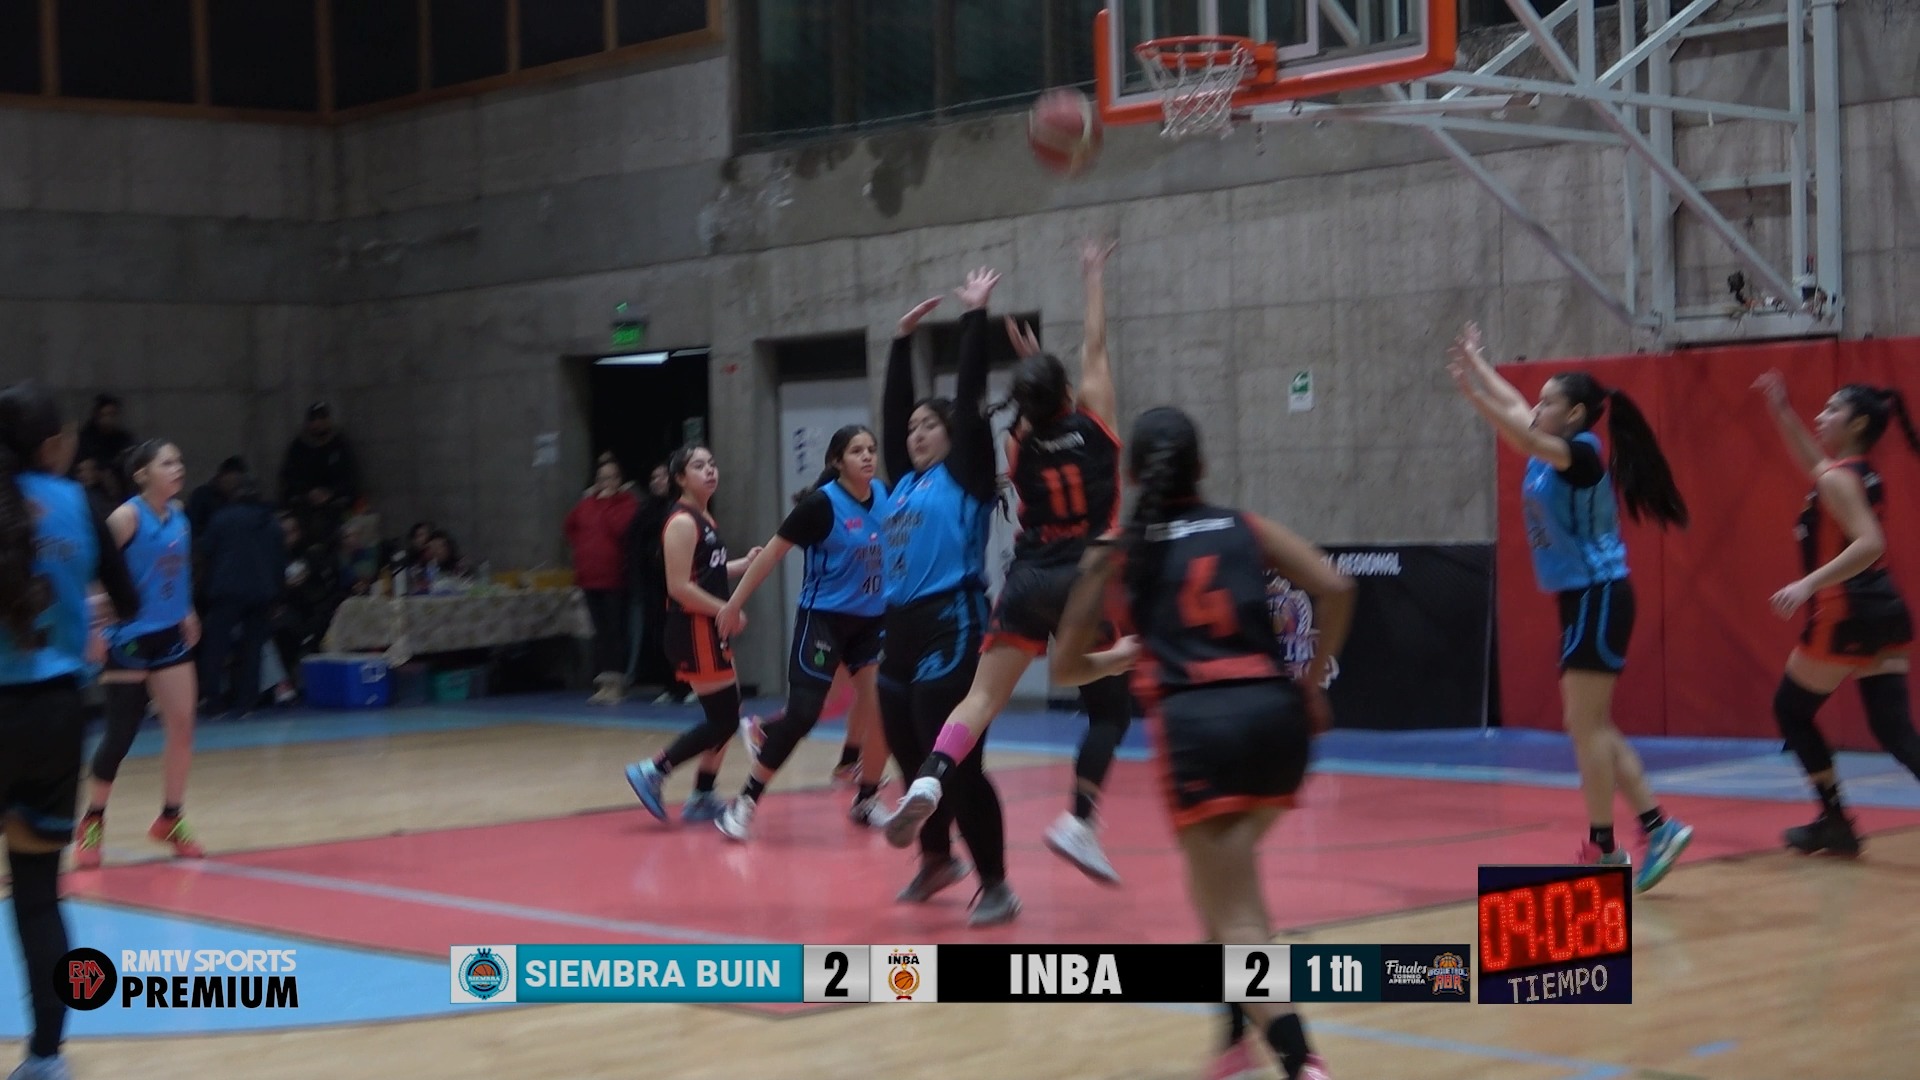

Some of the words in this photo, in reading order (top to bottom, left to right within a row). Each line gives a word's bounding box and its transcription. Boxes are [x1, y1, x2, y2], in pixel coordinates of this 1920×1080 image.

[1041, 463, 1088, 518] 11
[1337, 552, 1402, 576] REGIONAL
[1177, 555, 1239, 639] 4
